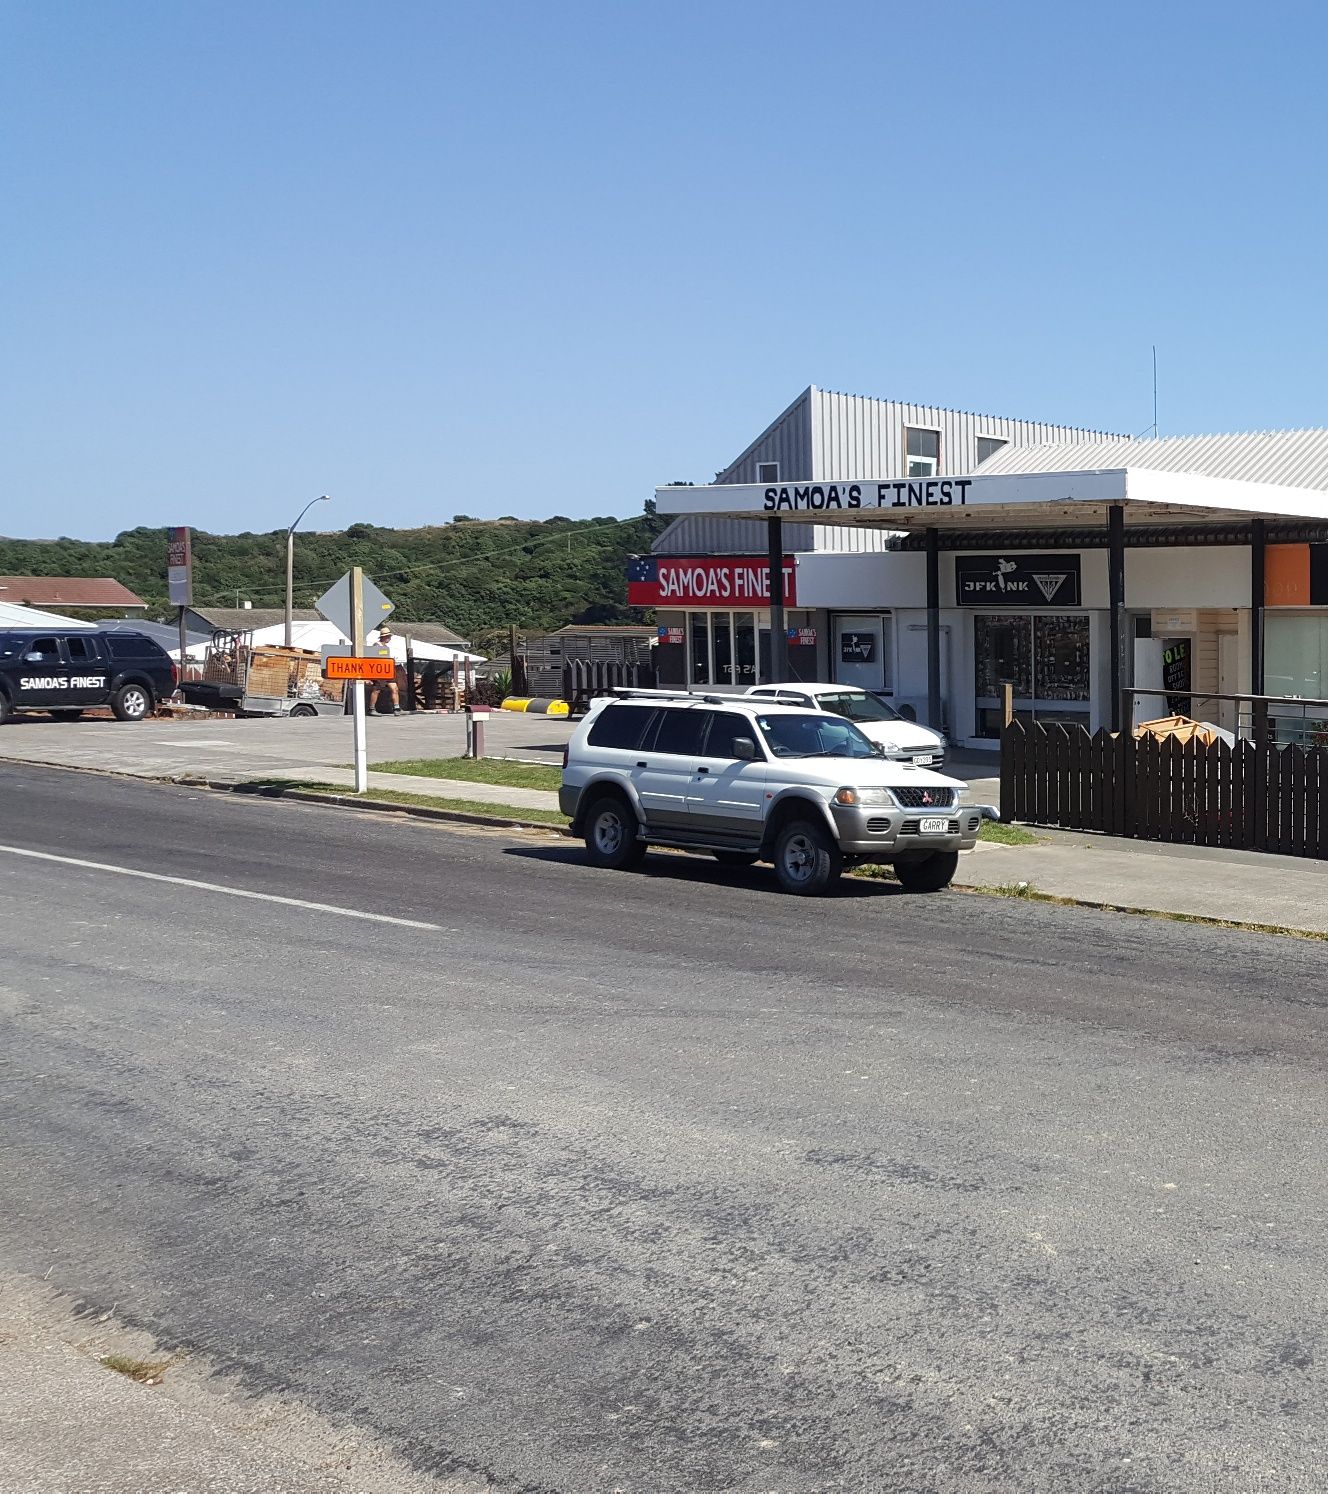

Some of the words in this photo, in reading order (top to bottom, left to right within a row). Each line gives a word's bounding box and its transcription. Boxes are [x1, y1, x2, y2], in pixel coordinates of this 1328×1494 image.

[764, 484, 862, 511] SAMOA'S
[877, 480, 973, 508] FINEST
[658, 567, 731, 598] SAMOA'S
[734, 567, 793, 598] FINET
[964, 581, 997, 591] JFK
[798, 627, 817, 637] SAMOA'S
[669, 635, 683, 644] FINEST
[800, 636, 815, 646] FINEST
[330, 662, 365, 674] THANK
[368, 663, 391, 674] YOU
[20, 677, 68, 690] SAMOA'S
[70, 676, 106, 689] FINEST
[922, 820, 946, 831] GARRY
